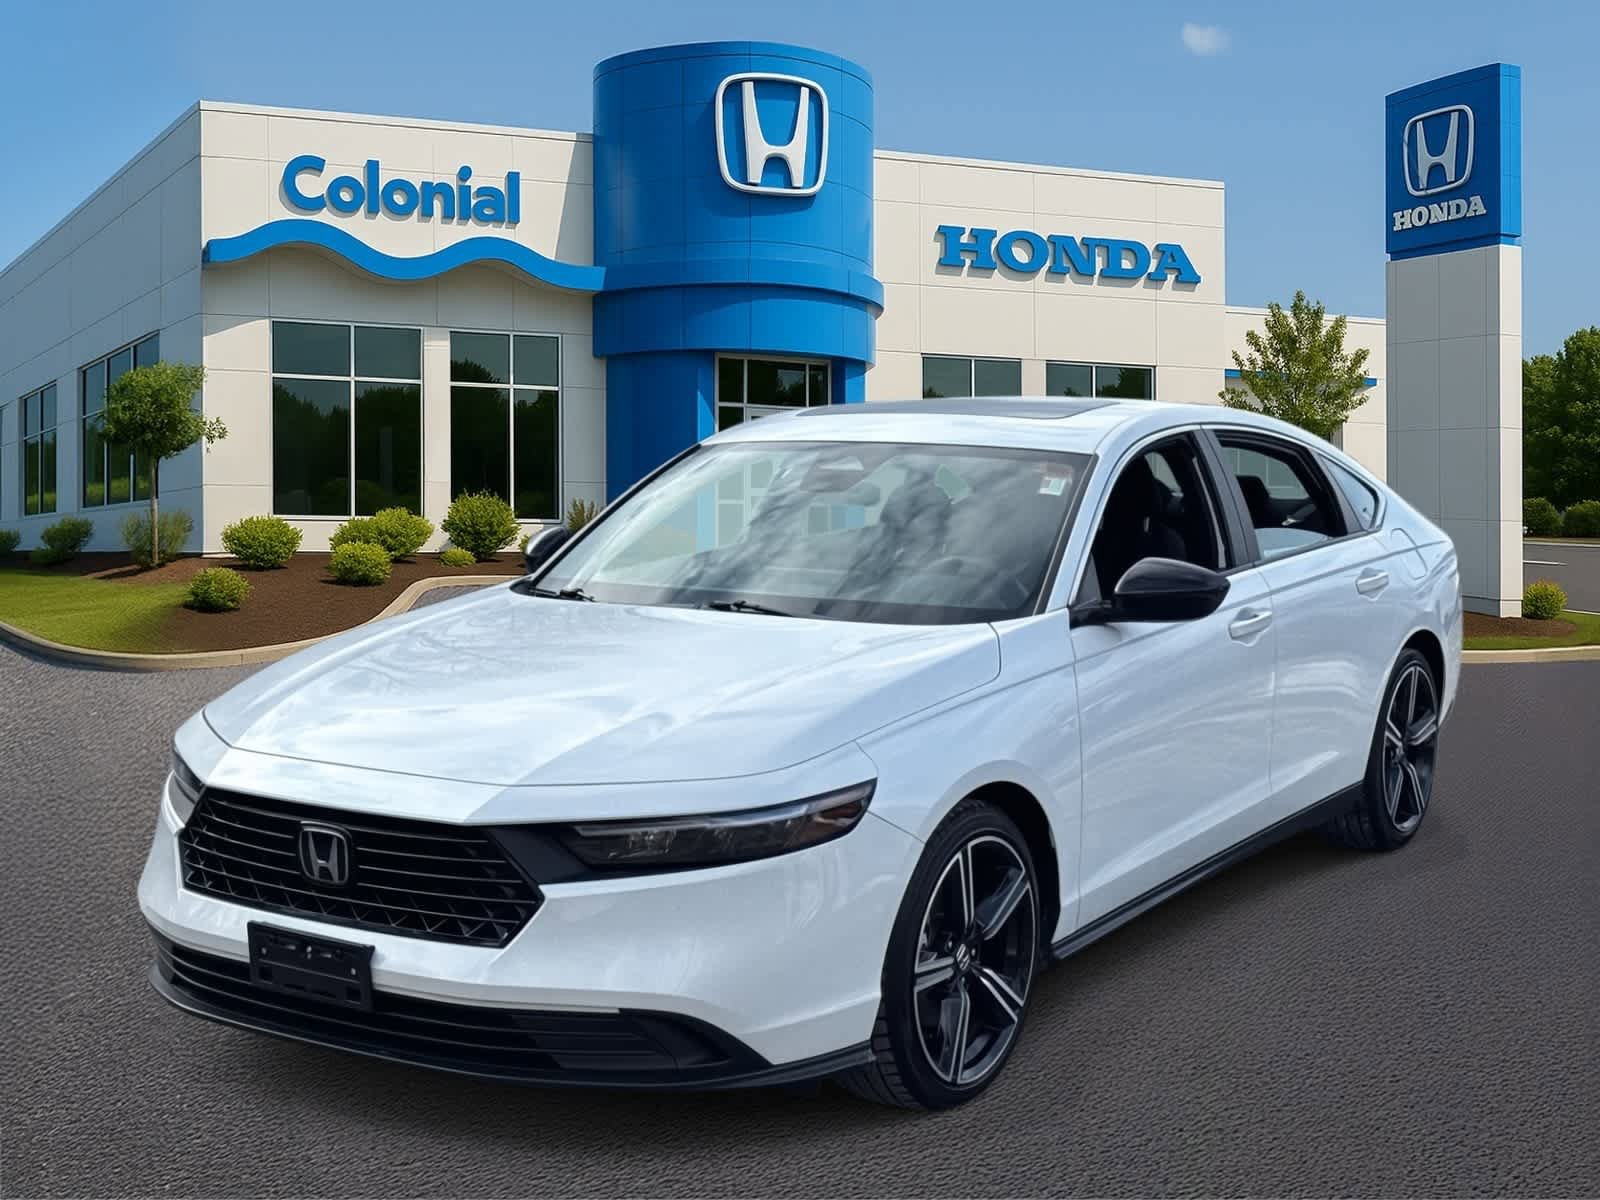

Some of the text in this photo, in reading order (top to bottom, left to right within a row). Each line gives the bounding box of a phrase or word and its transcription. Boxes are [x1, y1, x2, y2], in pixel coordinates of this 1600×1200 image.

[282, 154, 521, 225] Colonial
[1392, 195, 1487, 232] HONDA
[936, 224, 1201, 286] HONDA
